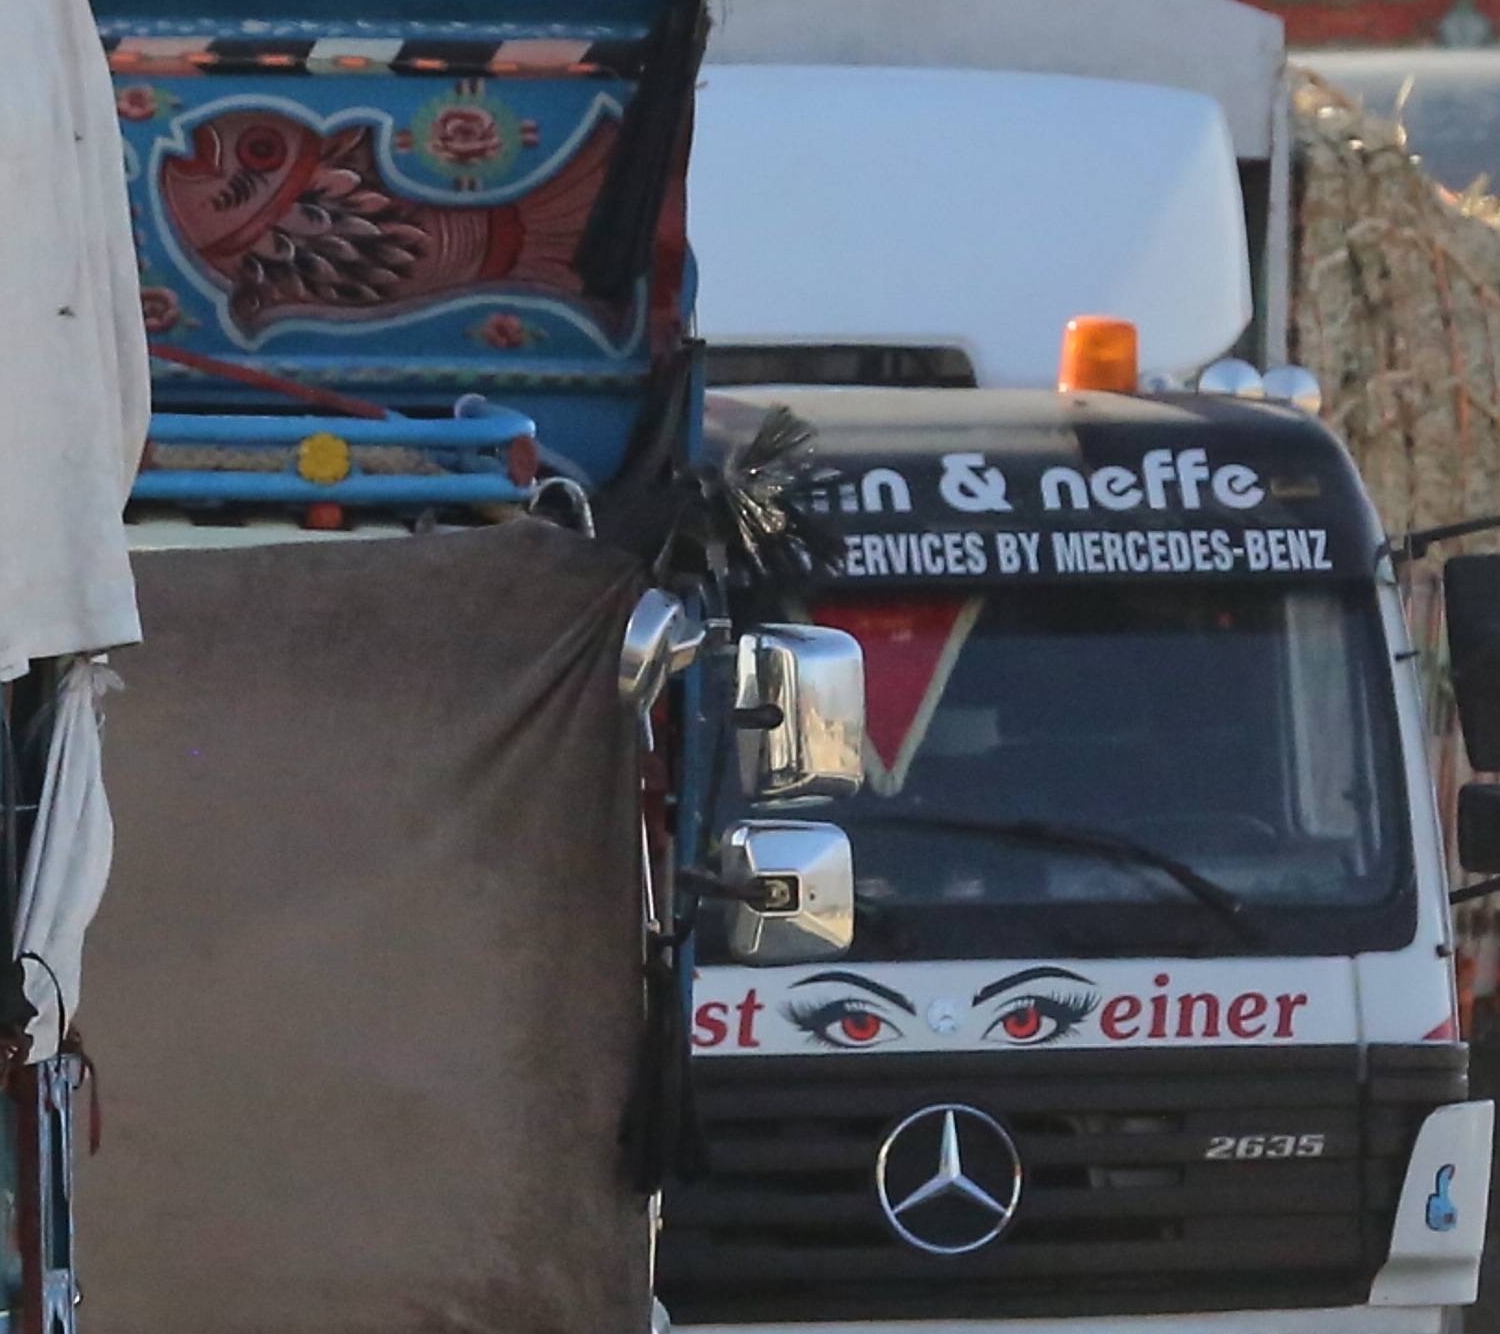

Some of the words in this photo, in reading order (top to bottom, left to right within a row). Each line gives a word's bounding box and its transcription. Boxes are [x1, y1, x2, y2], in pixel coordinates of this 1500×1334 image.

[939, 451, 1013, 513] &
[1042, 448, 1266, 511] neffe
[833, 531, 987, 576] ERVICES
[996, 531, 1041, 574] BY
[1053, 528, 1334, 573] MERCEDES-BENZ
[691, 986, 766, 1047] st
[1100, 973, 1309, 1043] einer
[1204, 1134, 1327, 1162] 2635
